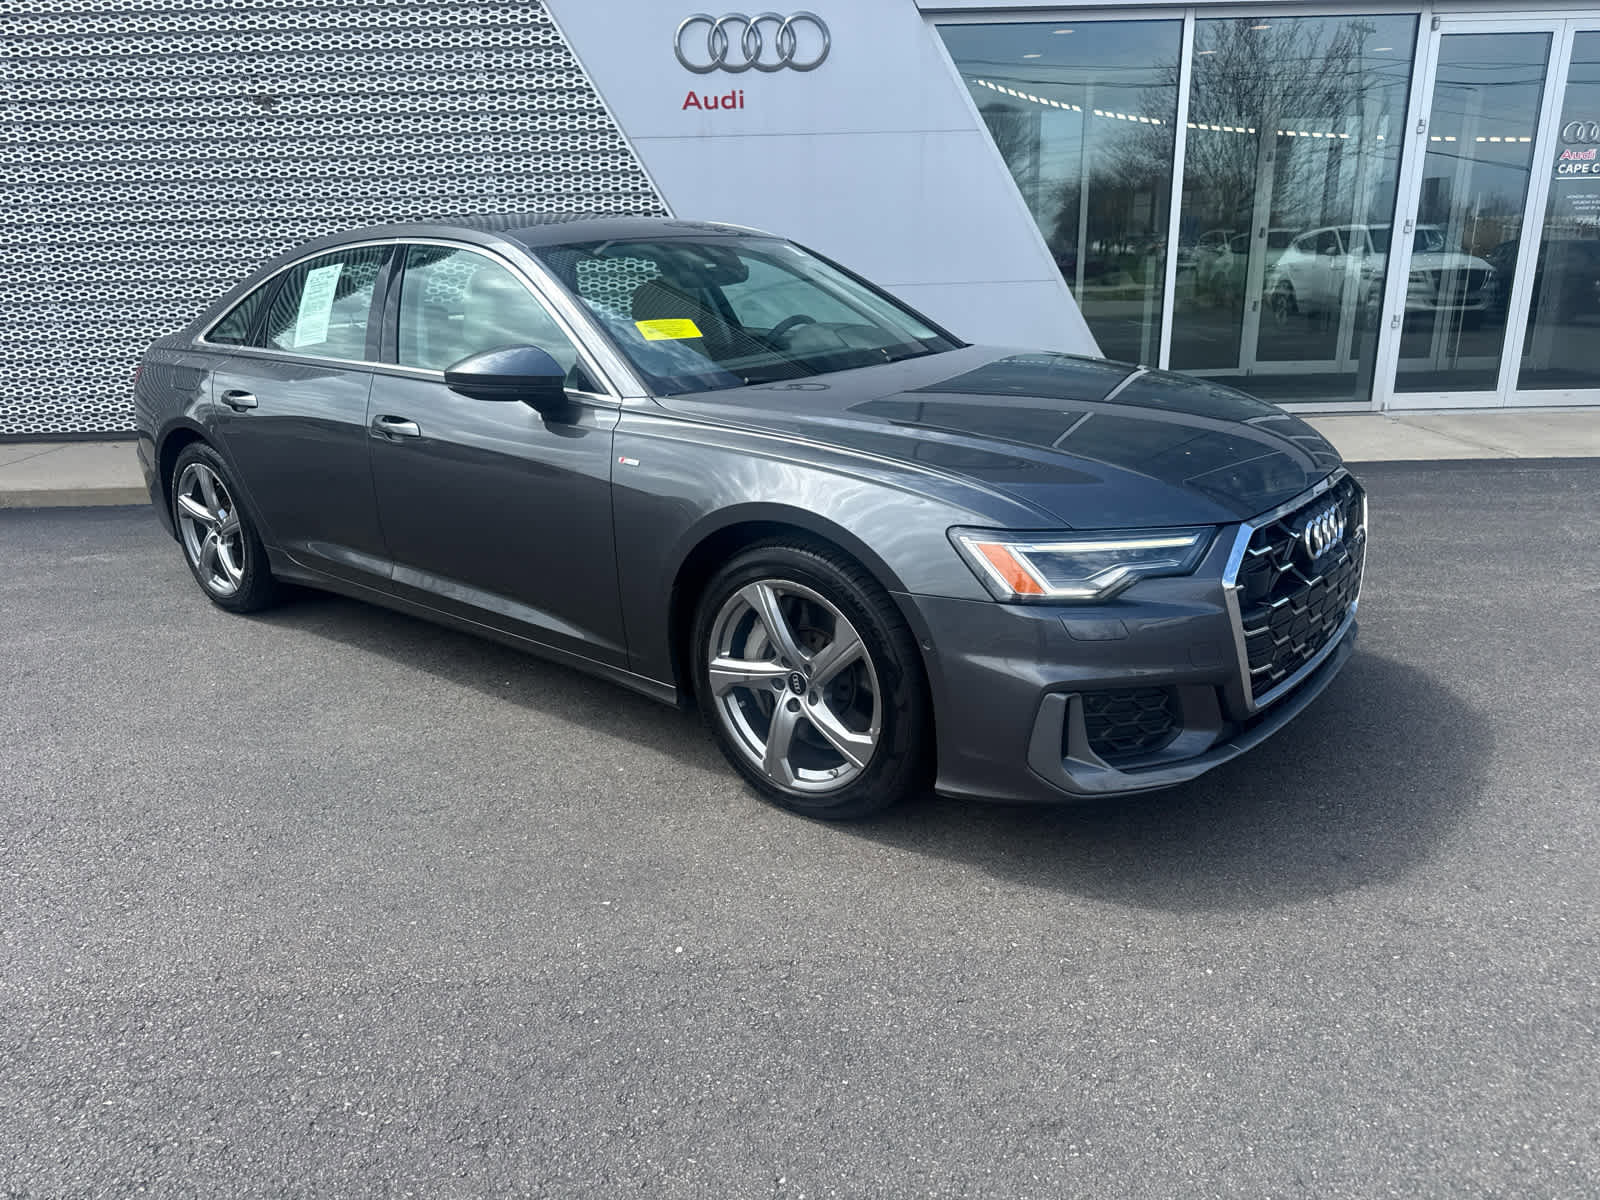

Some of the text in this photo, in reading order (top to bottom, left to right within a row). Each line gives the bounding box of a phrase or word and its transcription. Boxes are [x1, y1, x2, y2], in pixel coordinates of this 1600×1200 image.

[682, 89, 745, 110] Audi
[1559, 148, 1597, 160] Audi
[1558, 163, 1590, 174] CAPE
